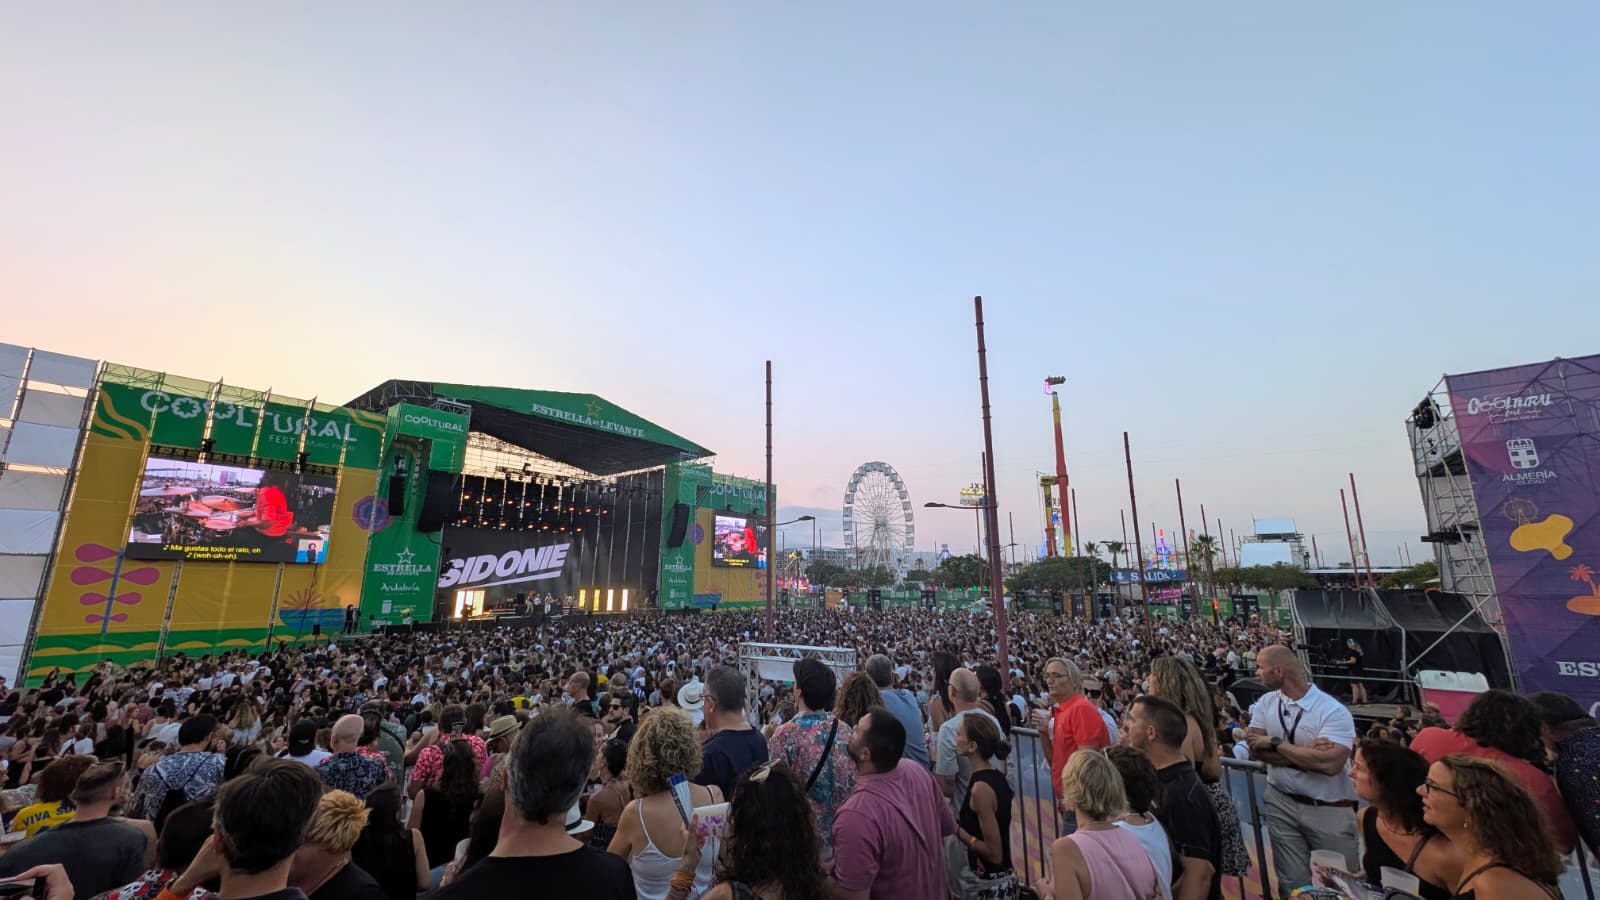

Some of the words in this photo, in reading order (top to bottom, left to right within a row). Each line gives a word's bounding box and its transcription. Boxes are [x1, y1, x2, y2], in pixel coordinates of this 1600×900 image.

[139, 389, 358, 442] COOLTURAL
[404, 414, 464, 432] COOLTURAL
[532, 403, 593, 426] ESTRELLA
[599, 420, 645, 437] LEVANTE
[268, 434, 296, 445] FEST
[1502, 469, 1557, 482] ALMERÍA
[373, 563, 432, 573] ESTRELLA
[438, 543, 571, 588] SIDONIE
[1555, 661, 1600, 677] ES
[23, 810, 51, 826] VIVA
